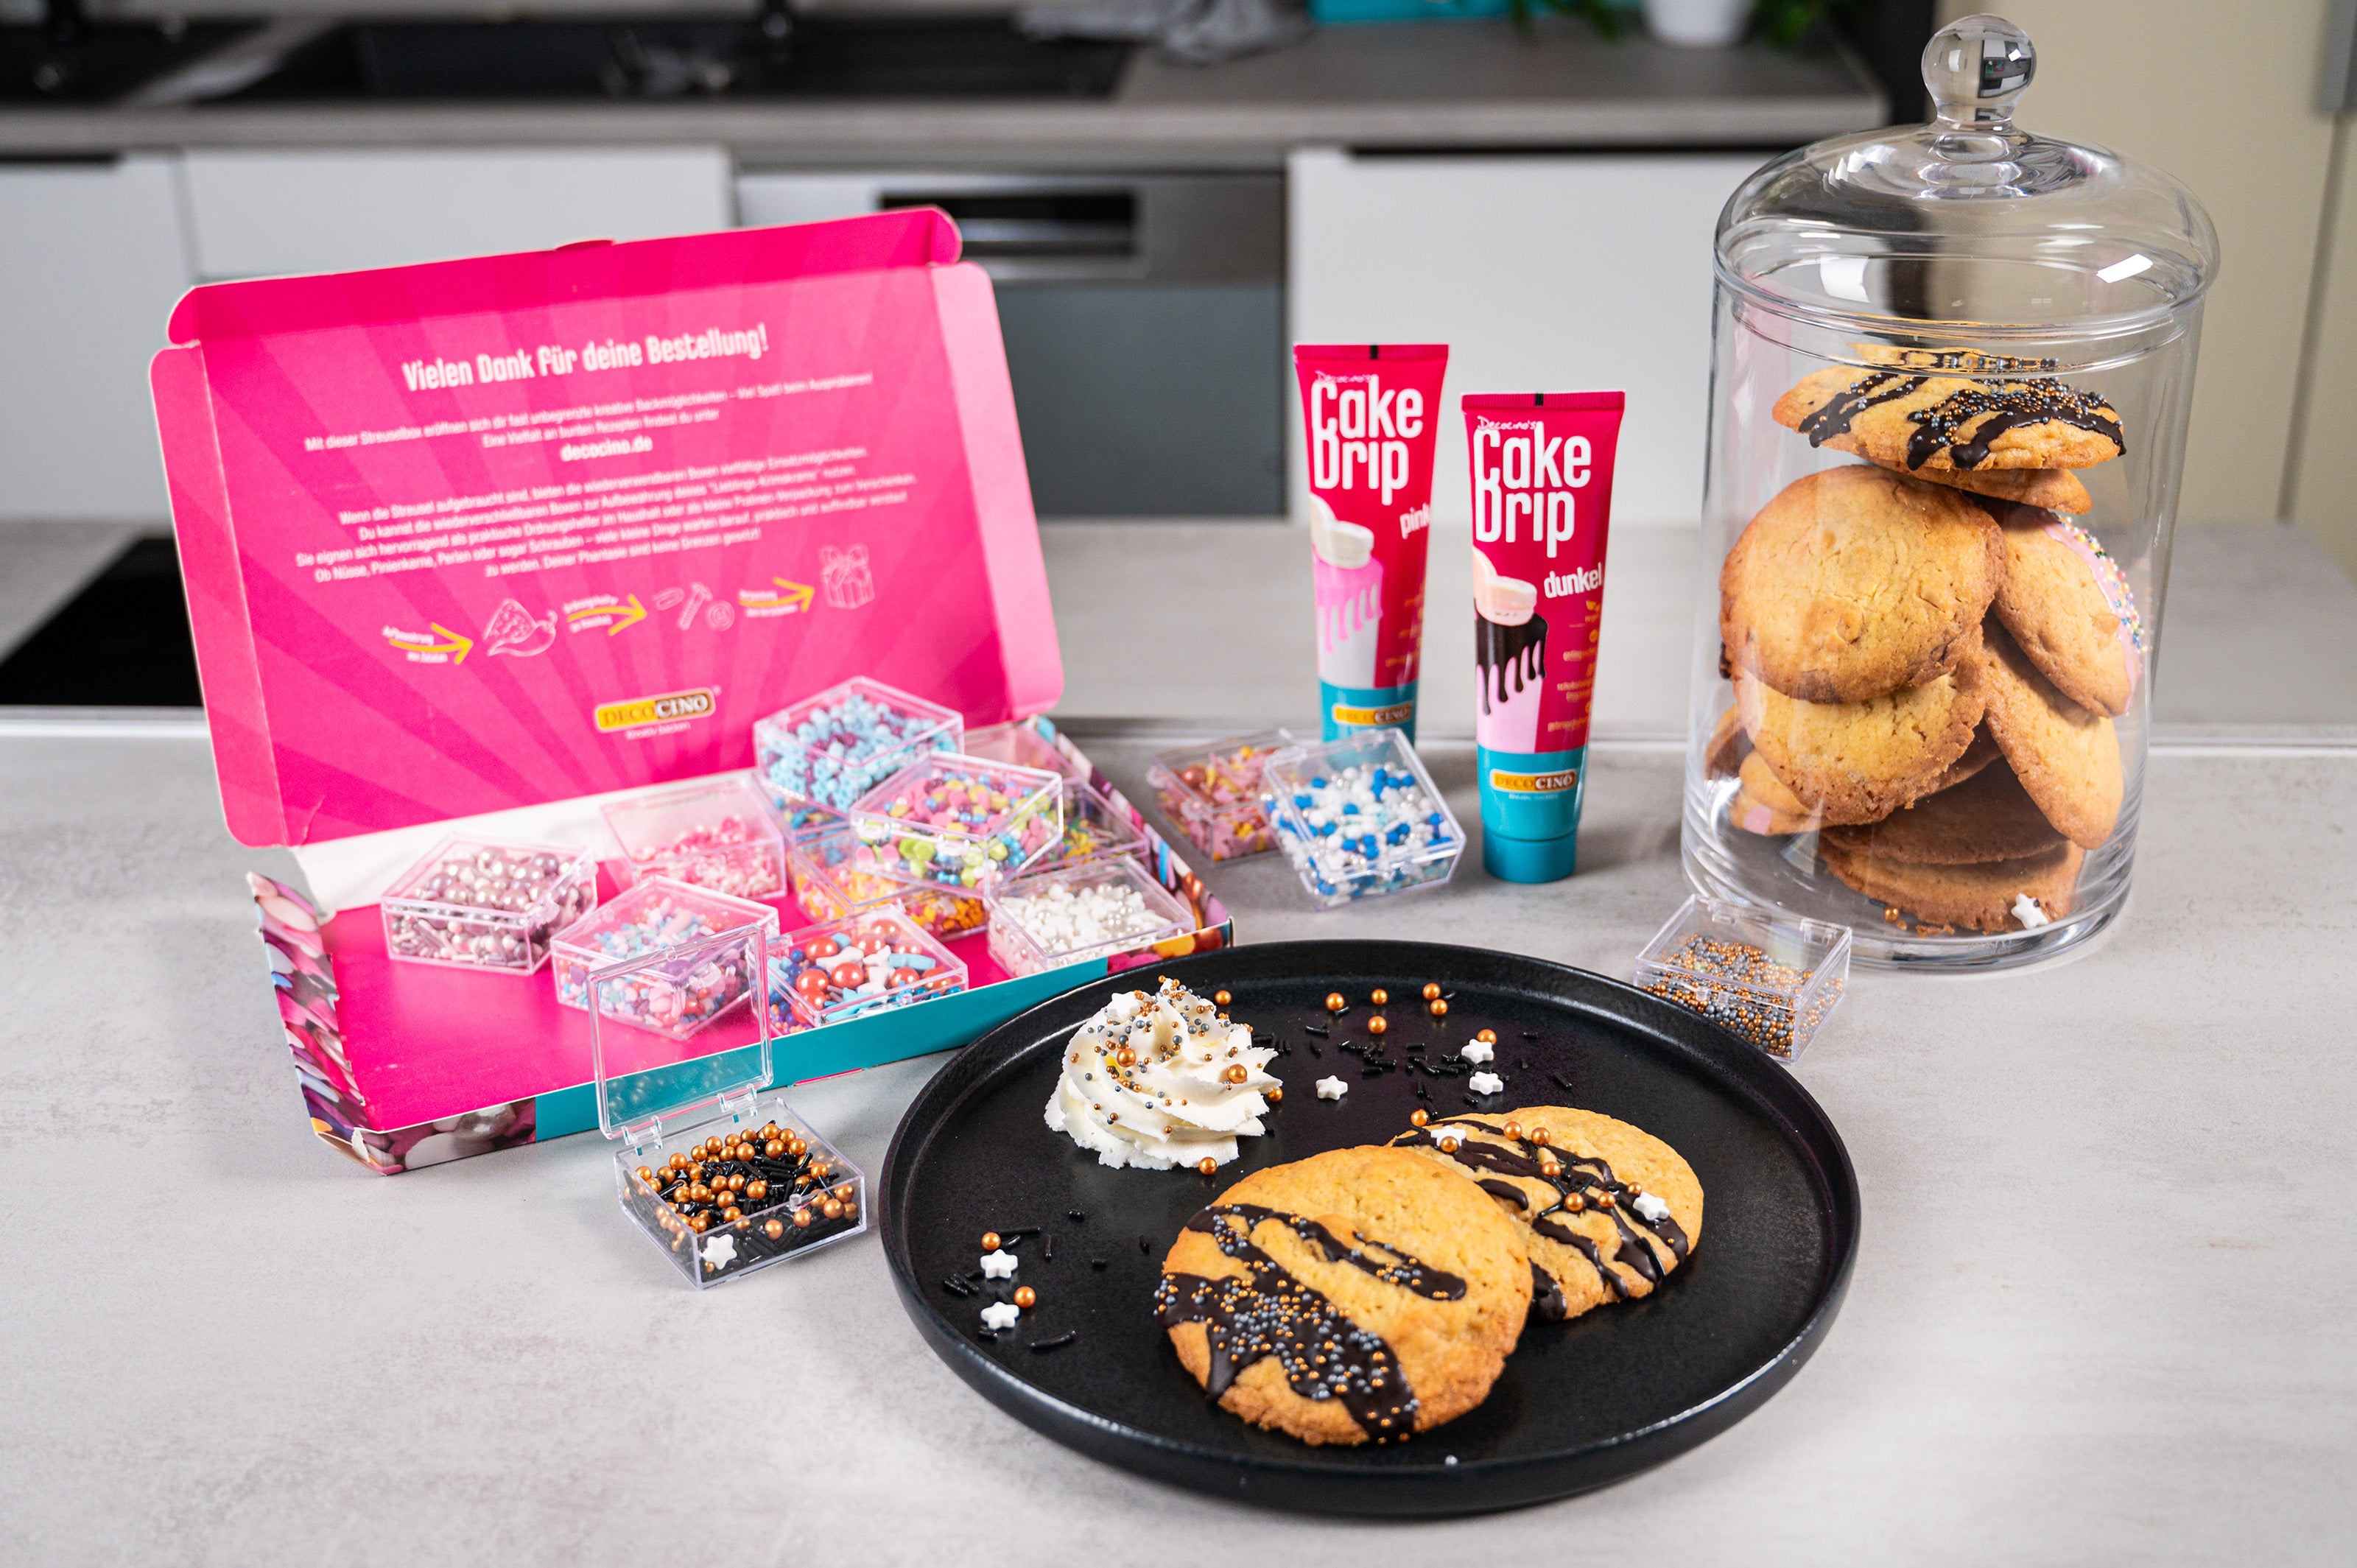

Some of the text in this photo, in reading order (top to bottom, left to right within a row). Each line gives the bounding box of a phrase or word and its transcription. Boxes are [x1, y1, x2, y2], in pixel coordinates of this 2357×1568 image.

[402, 323, 768, 391] Vielen Dank für deine Bestellung!
[1311, 374, 1423, 438] Cake
[1477, 415, 1536, 430] Decocino's
[304, 437, 324, 451] Mit
[560, 435, 653, 461] decocino.de
[1474, 421, 1591, 488] Cake
[1314, 433, 1408, 505] Drip
[338, 510, 371, 524] Wenn
[390, 501, 435, 518] Streusel
[1475, 480, 1576, 558] Drip
[357, 527, 376, 541] Du
[295, 552, 315, 566] Sie
[314, 568, 331, 582] Ob
[1544, 563, 1602, 599] dunkel
[604, 695, 709, 725] DECOCINO
